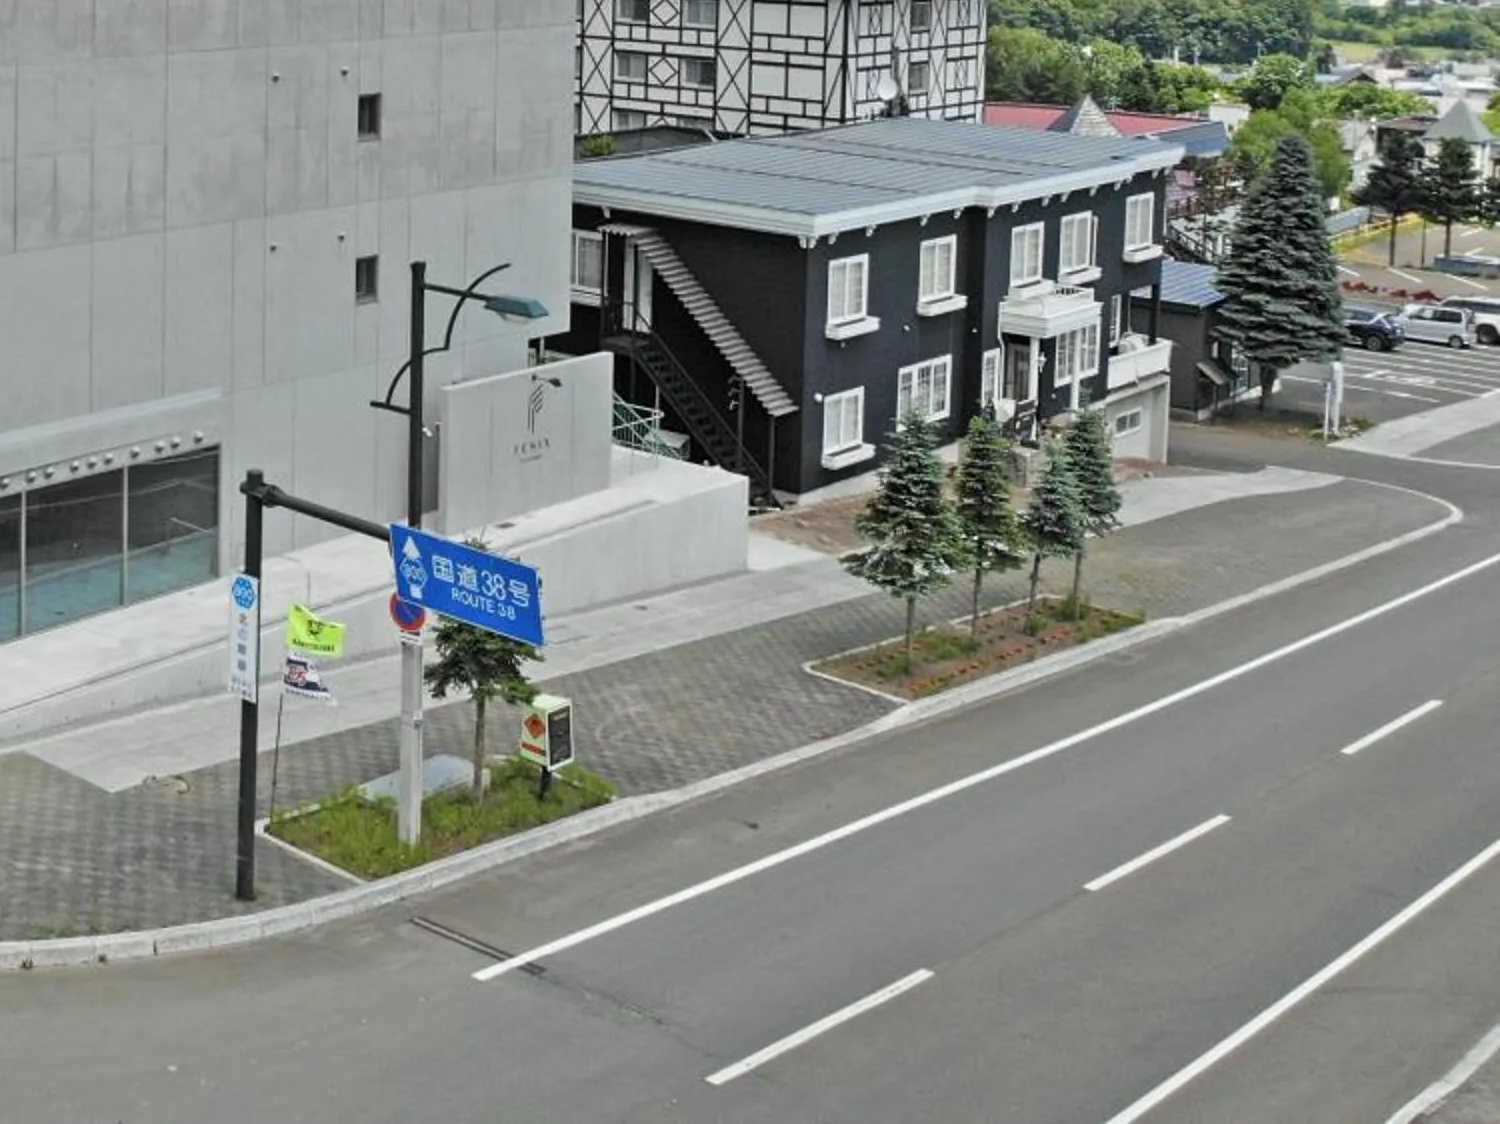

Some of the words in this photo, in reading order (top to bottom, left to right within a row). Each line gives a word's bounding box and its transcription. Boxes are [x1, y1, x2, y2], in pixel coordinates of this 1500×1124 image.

[431, 555, 531, 607] 国道38号
[451, 587, 495, 614] ROUTE
[498, 602, 517, 621] 38
